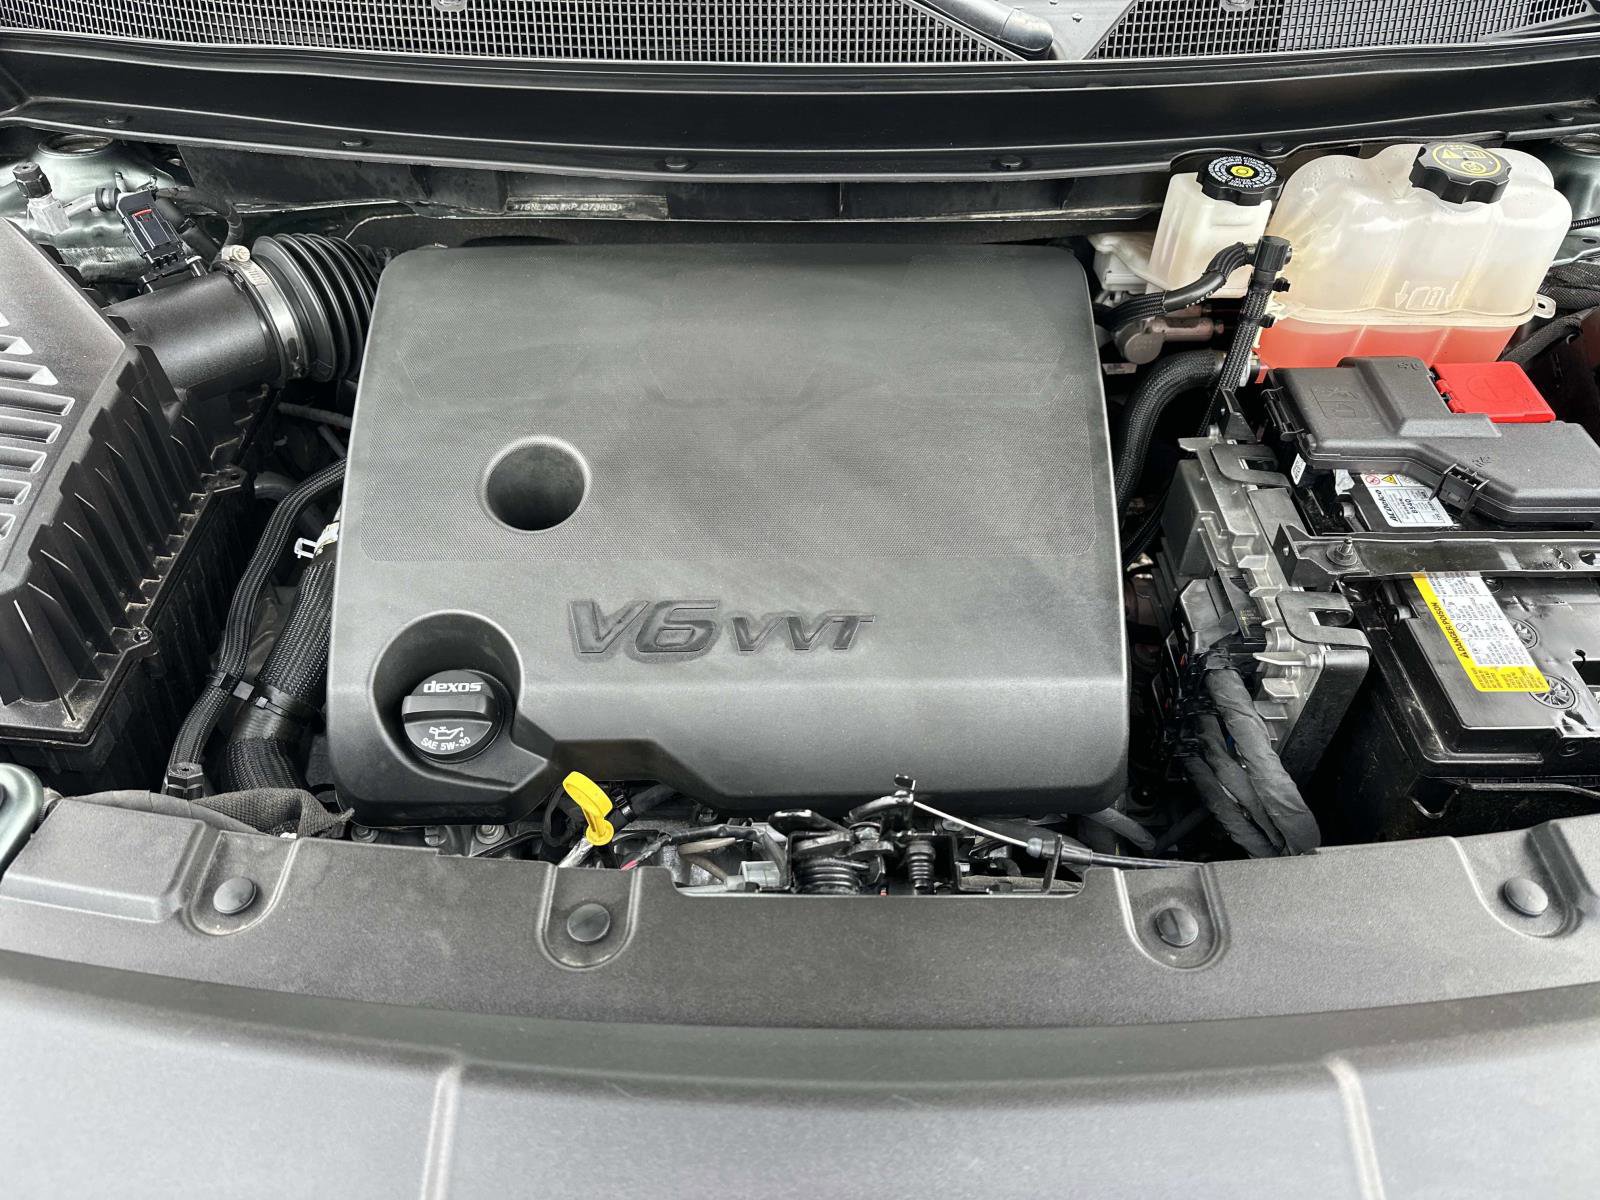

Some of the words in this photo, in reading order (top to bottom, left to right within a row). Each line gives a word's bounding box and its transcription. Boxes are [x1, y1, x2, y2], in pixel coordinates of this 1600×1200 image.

[568, 599, 720, 658] V6
[729, 612, 877, 653] VVT
[423, 680, 484, 693] dexos
[420, 737, 439, 751] SAE
[440, 736, 471, 751] 5W-30
